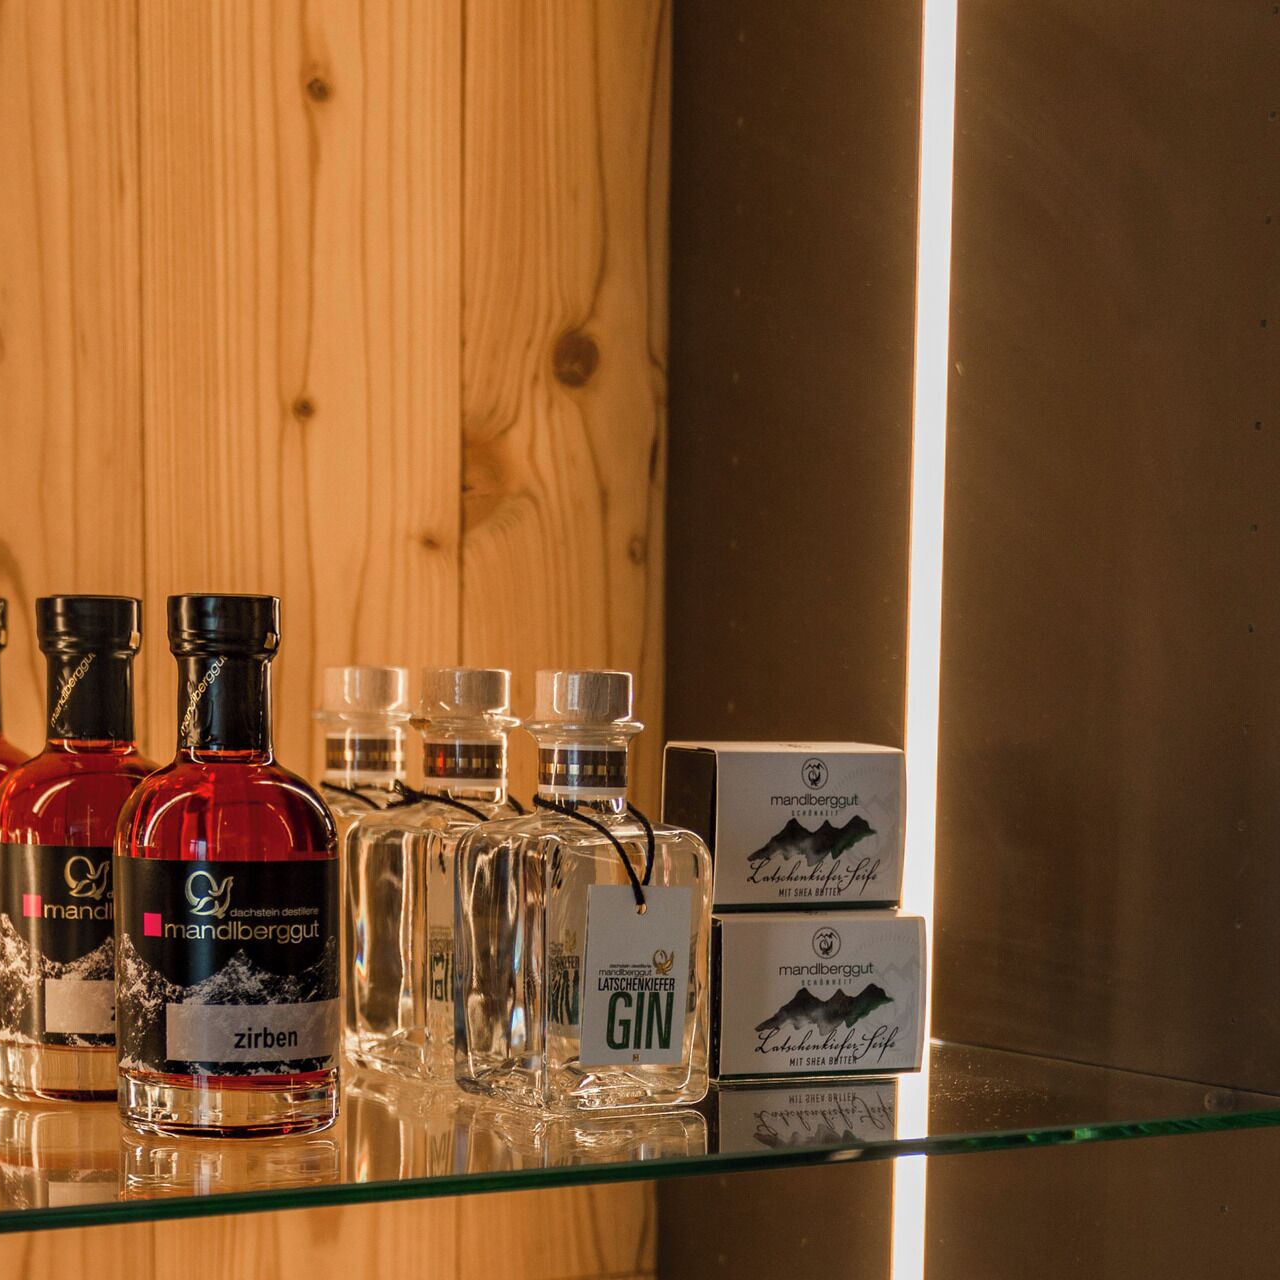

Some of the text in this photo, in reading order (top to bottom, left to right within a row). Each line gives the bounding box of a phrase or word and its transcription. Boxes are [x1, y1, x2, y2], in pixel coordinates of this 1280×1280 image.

[771, 794, 859, 809] mandlberggut
[778, 887, 842, 897] MIT SHEA BUTTER
[230, 907, 280, 918] dachstein
[164, 920, 319, 944] mandlberggut
[598, 969, 652, 977] mandlberggut
[779, 962, 875, 978] mandlberggut
[598, 977, 675, 992] LATSCHENKIEFER
[606, 991, 674, 1050] GIN
[233, 1027, 298, 1049] zirben
[789, 1055, 858, 1067] MIT SHEA BUTTER
